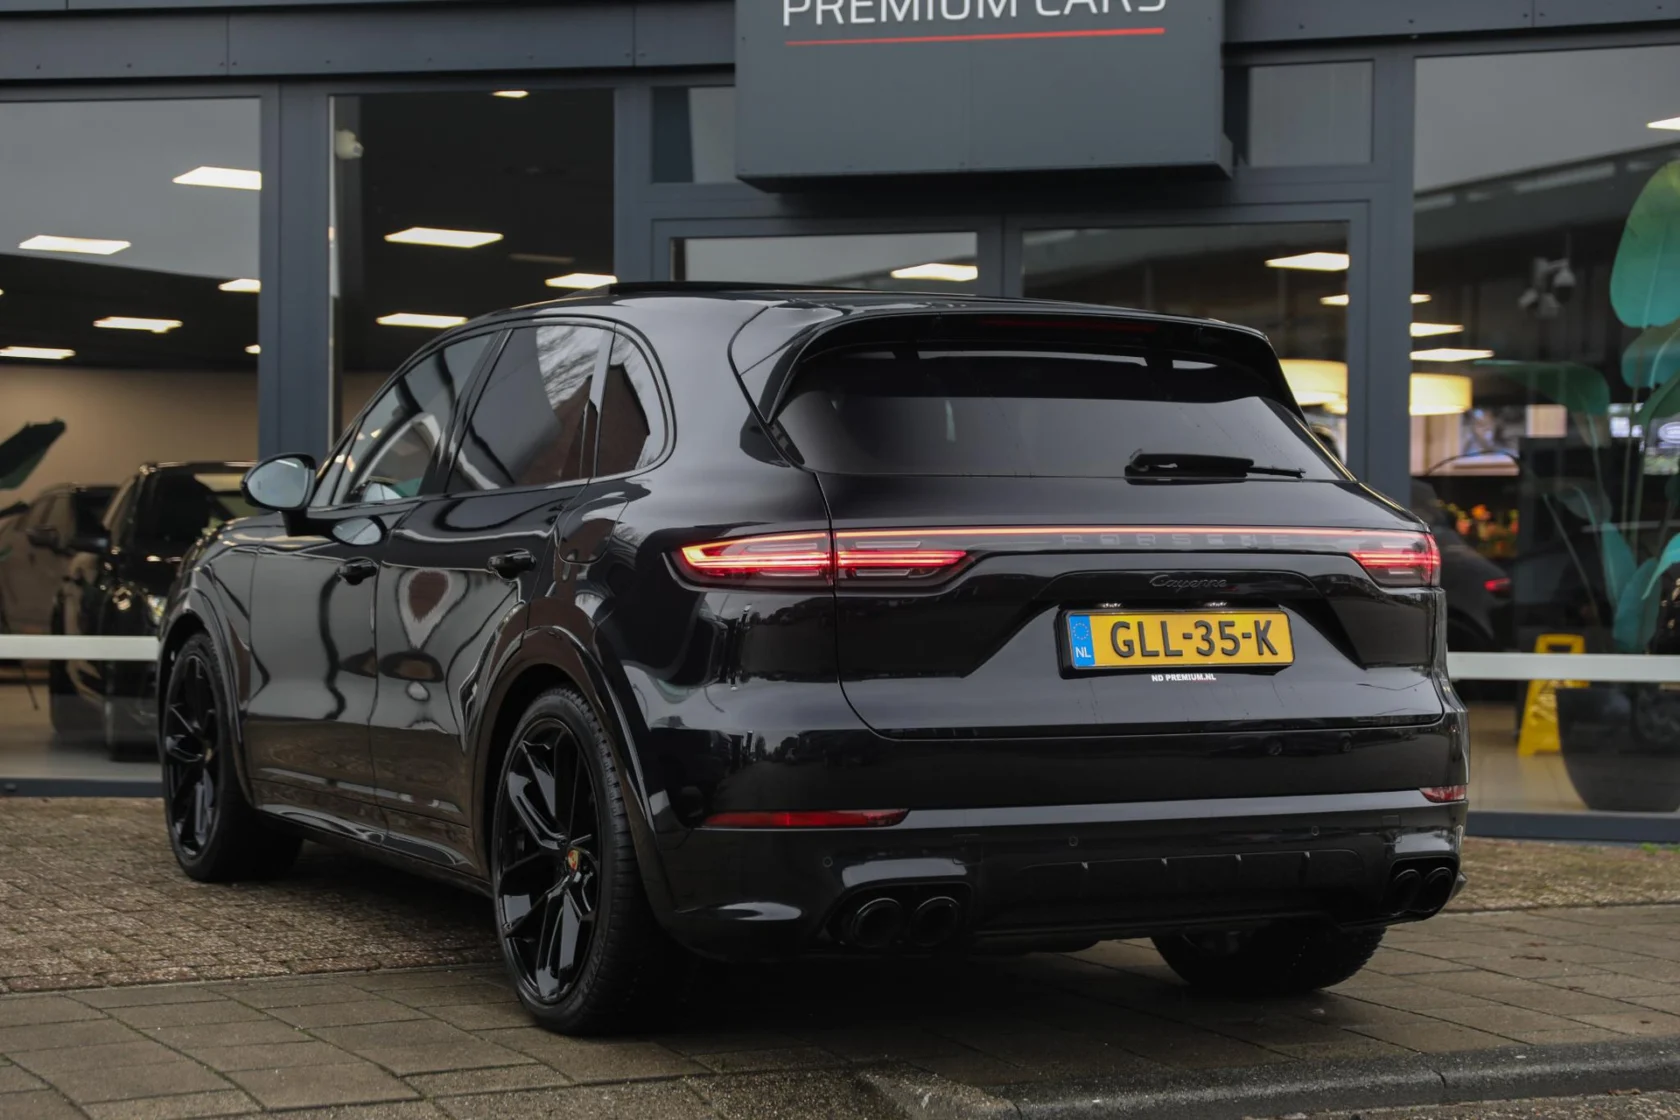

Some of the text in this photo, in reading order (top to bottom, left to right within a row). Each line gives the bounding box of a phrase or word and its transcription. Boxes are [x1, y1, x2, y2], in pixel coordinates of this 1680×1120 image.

[1149, 575, 1227, 593] Cayenne
[1110, 620, 1278, 657] GLL-35-K
[1075, 646, 1092, 658] NL
[1151, 673, 1217, 682] ND PREMIUM.NL
